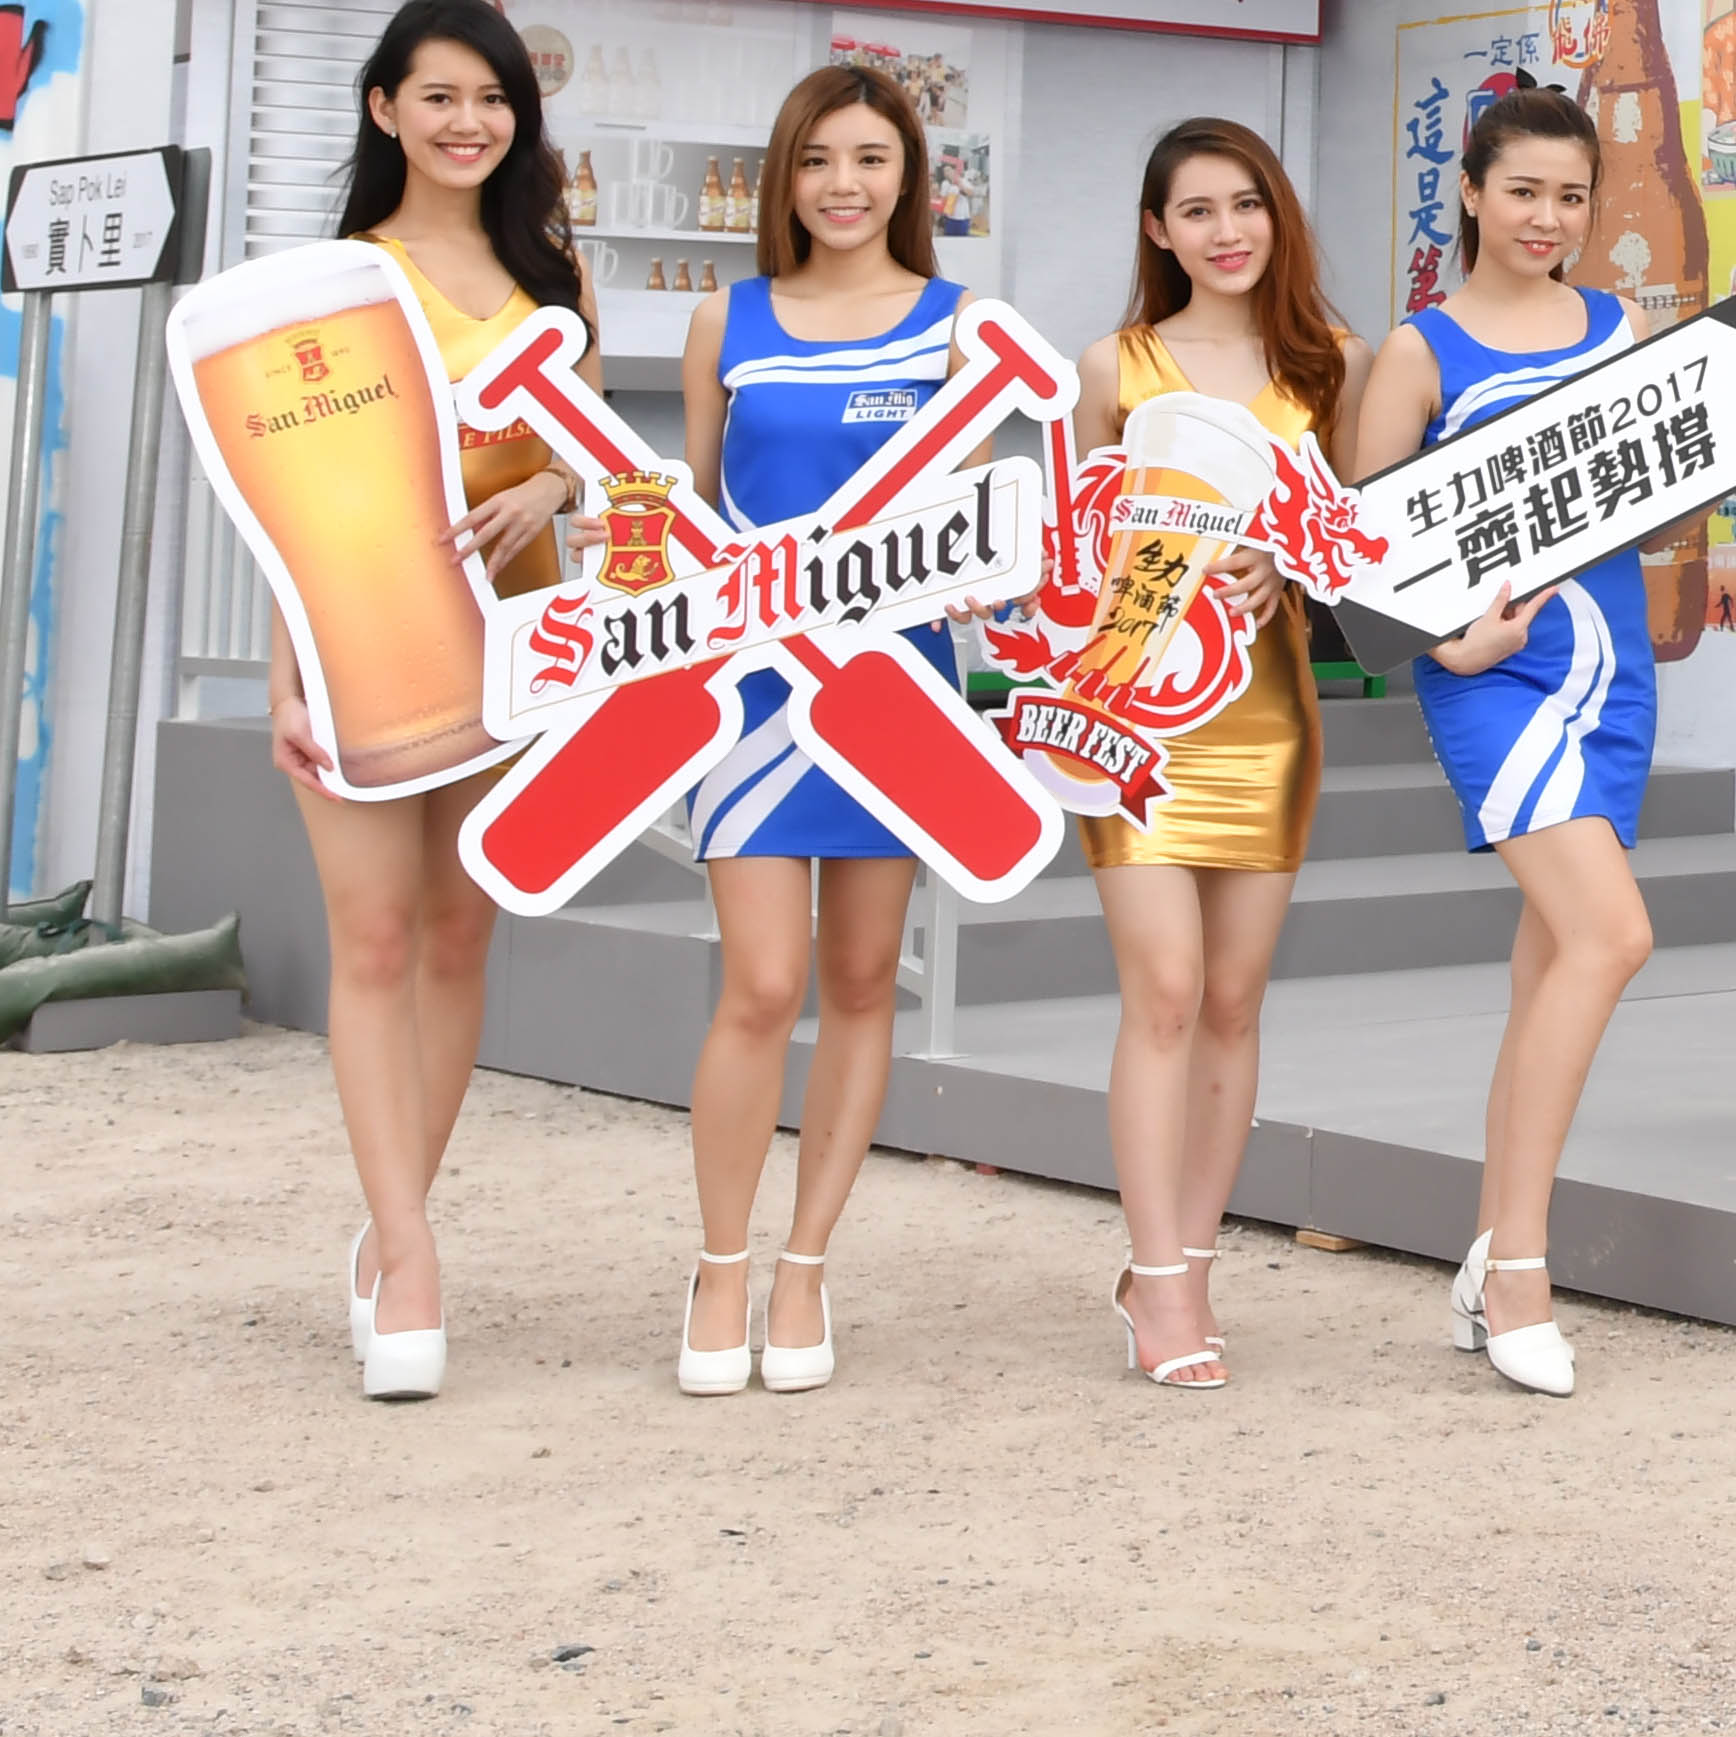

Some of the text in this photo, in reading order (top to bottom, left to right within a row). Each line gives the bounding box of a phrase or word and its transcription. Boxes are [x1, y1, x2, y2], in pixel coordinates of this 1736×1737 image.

[245, 373, 396, 439] San Miguel
[855, 409, 907, 419] LIGHT
[1405, 355, 1709, 538] 生力啤酒節2017
[1113, 496, 1247, 536] San Miguel
[528, 465, 999, 695] San Miguel
[1136, 539, 1189, 590] 生力
[1097, 605, 1158, 646] 2017
[1110, 573, 1182, 635] 啤酒節
[1016, 702, 1151, 783] BEER FEST
